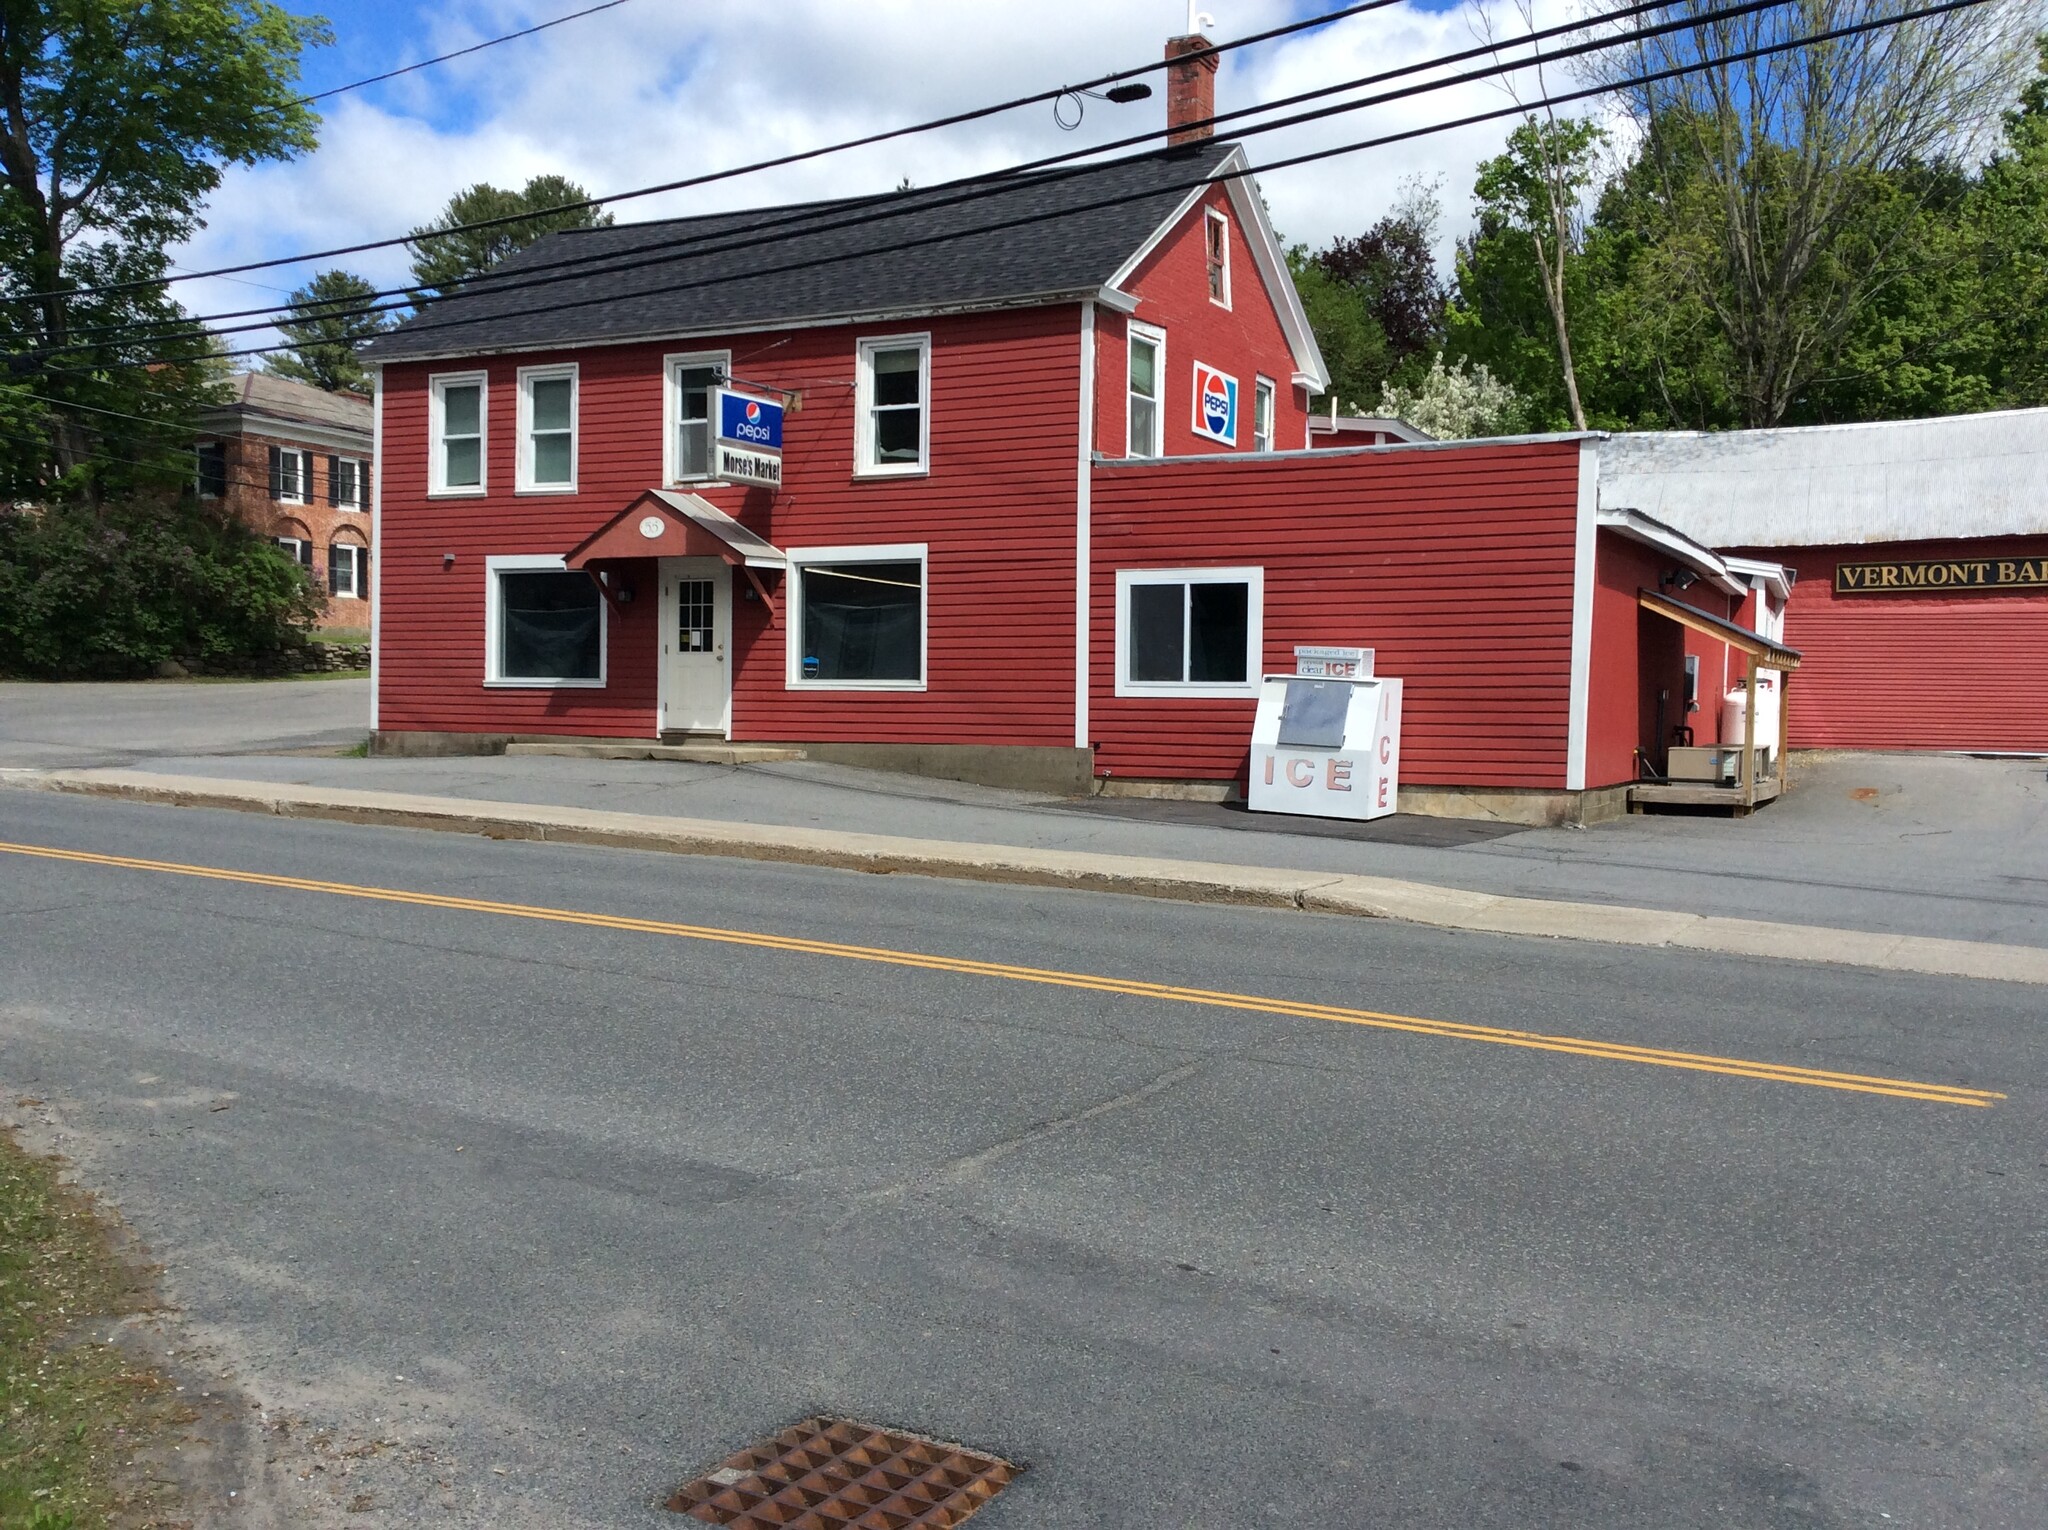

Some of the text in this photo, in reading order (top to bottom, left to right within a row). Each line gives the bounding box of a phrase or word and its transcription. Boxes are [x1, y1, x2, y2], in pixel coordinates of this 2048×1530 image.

[1205, 393, 1228, 416] PEPSI
[736, 423, 770, 440] pepsi
[723, 451, 780, 480] Morse's Market
[1842, 562, 1990, 587] VERMONT
[1302, 662, 1356, 676] clear ICE
[1264, 755, 1354, 791] ICE
